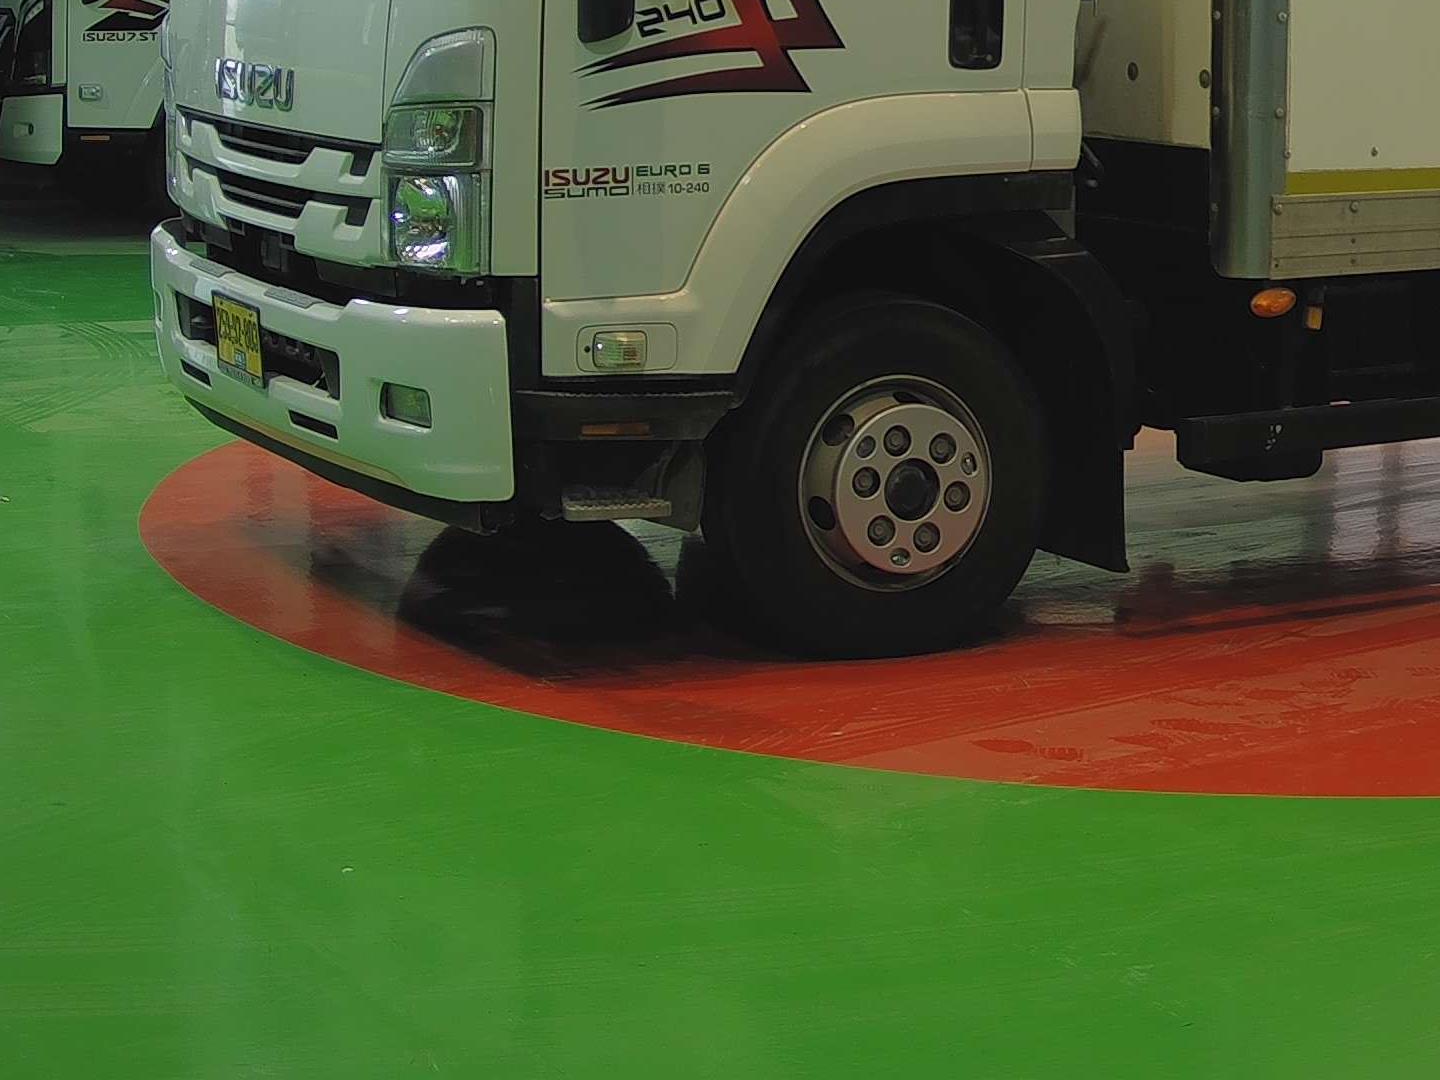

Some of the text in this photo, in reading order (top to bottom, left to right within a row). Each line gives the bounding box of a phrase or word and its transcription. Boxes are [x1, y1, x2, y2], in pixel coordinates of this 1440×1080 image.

[215, 57, 295, 112] ISUZU
[544, 166, 630, 187] ISUZU
[635, 163, 711, 177] EURO 6
[543, 185, 630, 200] SUMO
[667, 181, 710, 195] 10-240
